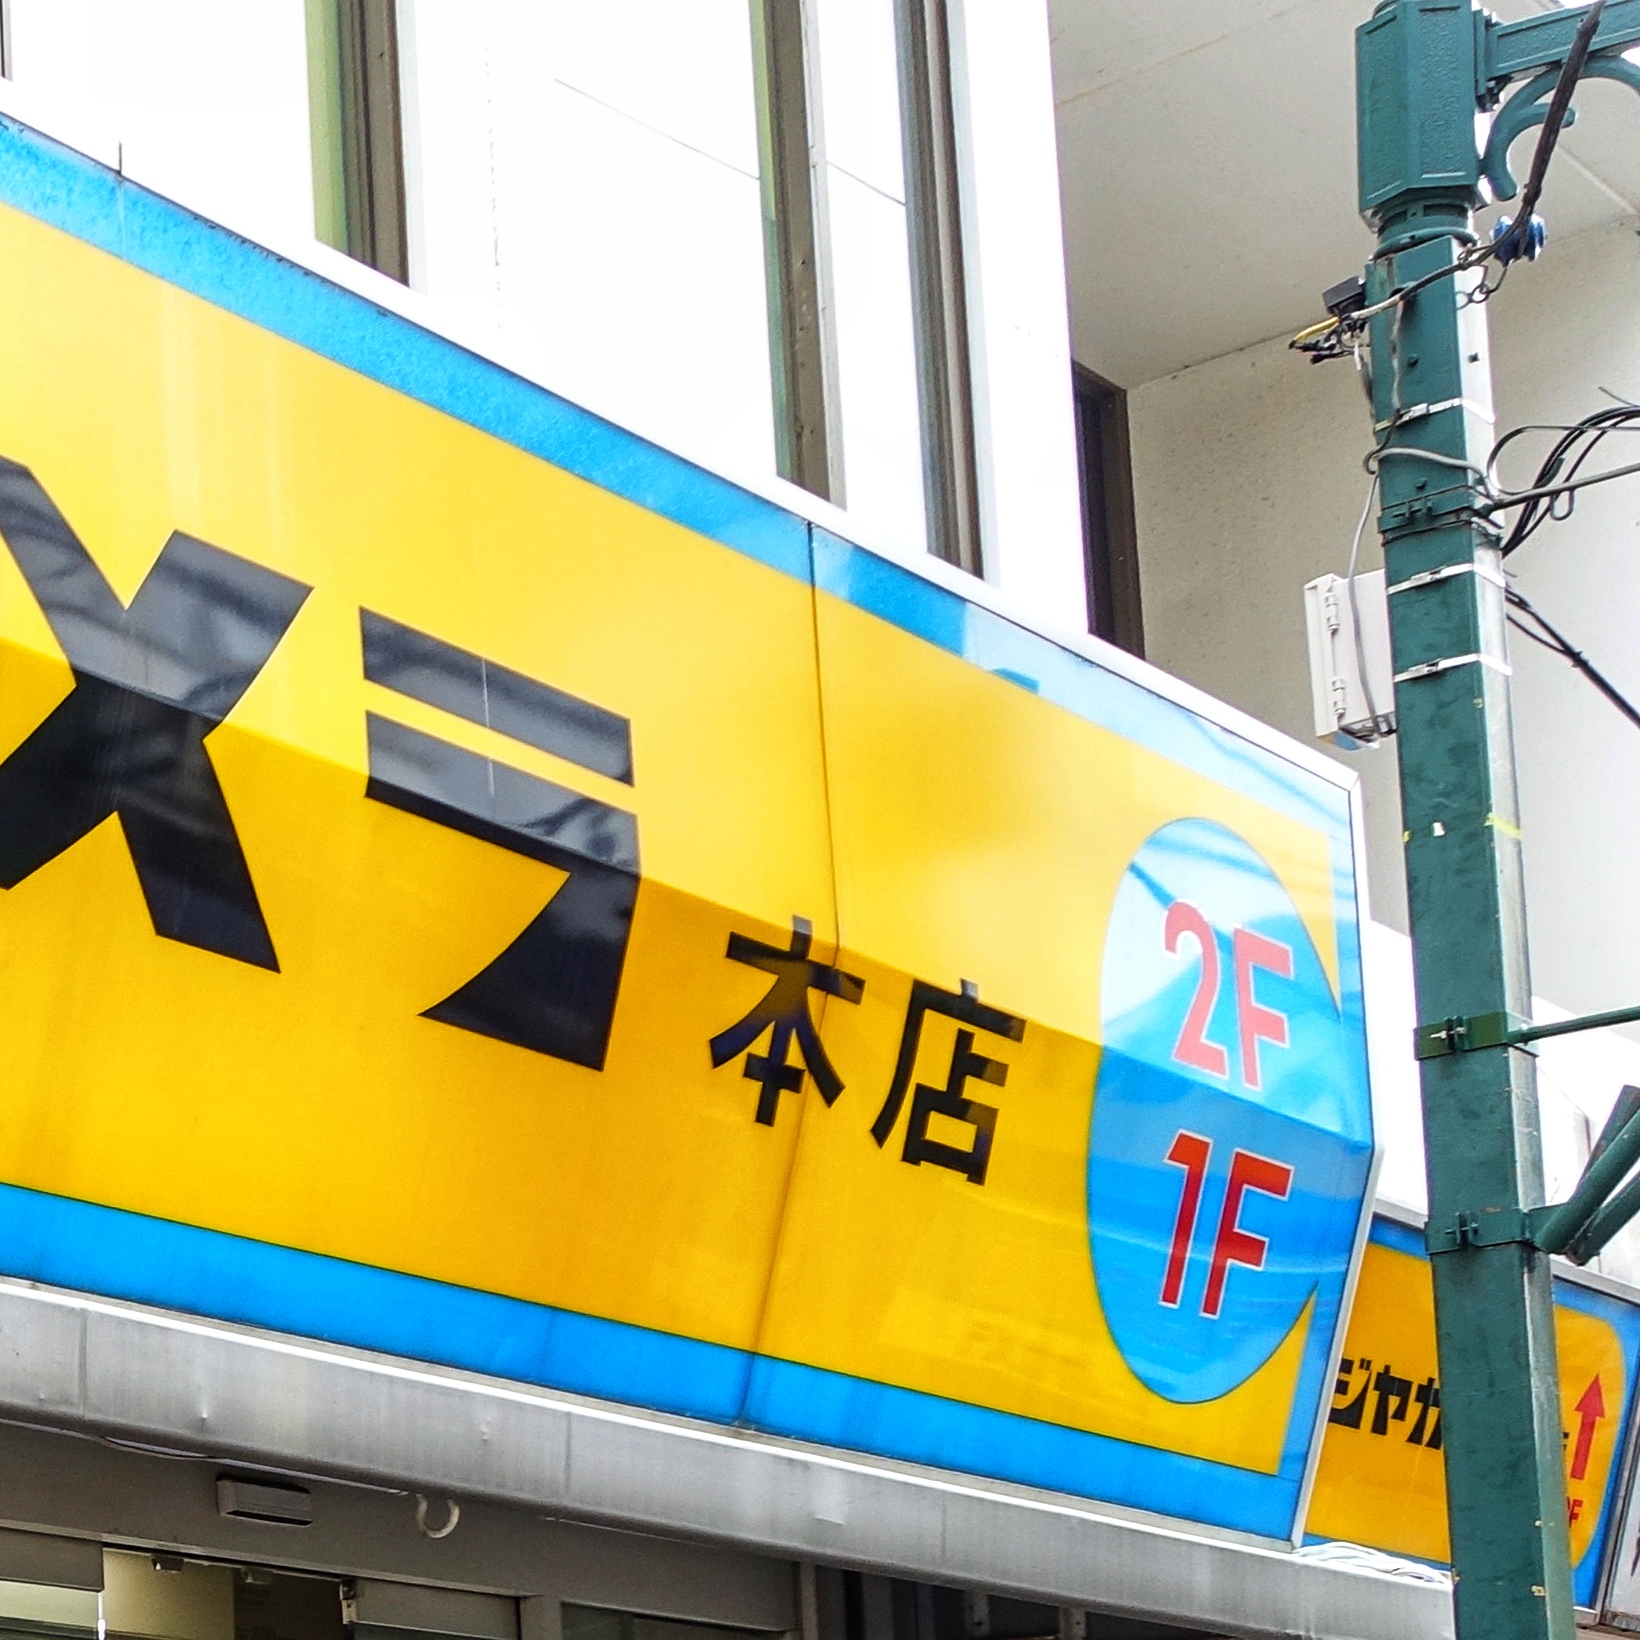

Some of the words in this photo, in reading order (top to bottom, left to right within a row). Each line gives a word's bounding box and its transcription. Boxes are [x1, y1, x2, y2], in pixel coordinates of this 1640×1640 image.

[709, 915, 1025, 1187] 本店
[1163, 900, 1293, 1091] 2F
[1161, 1132, 1295, 1320] 1F
